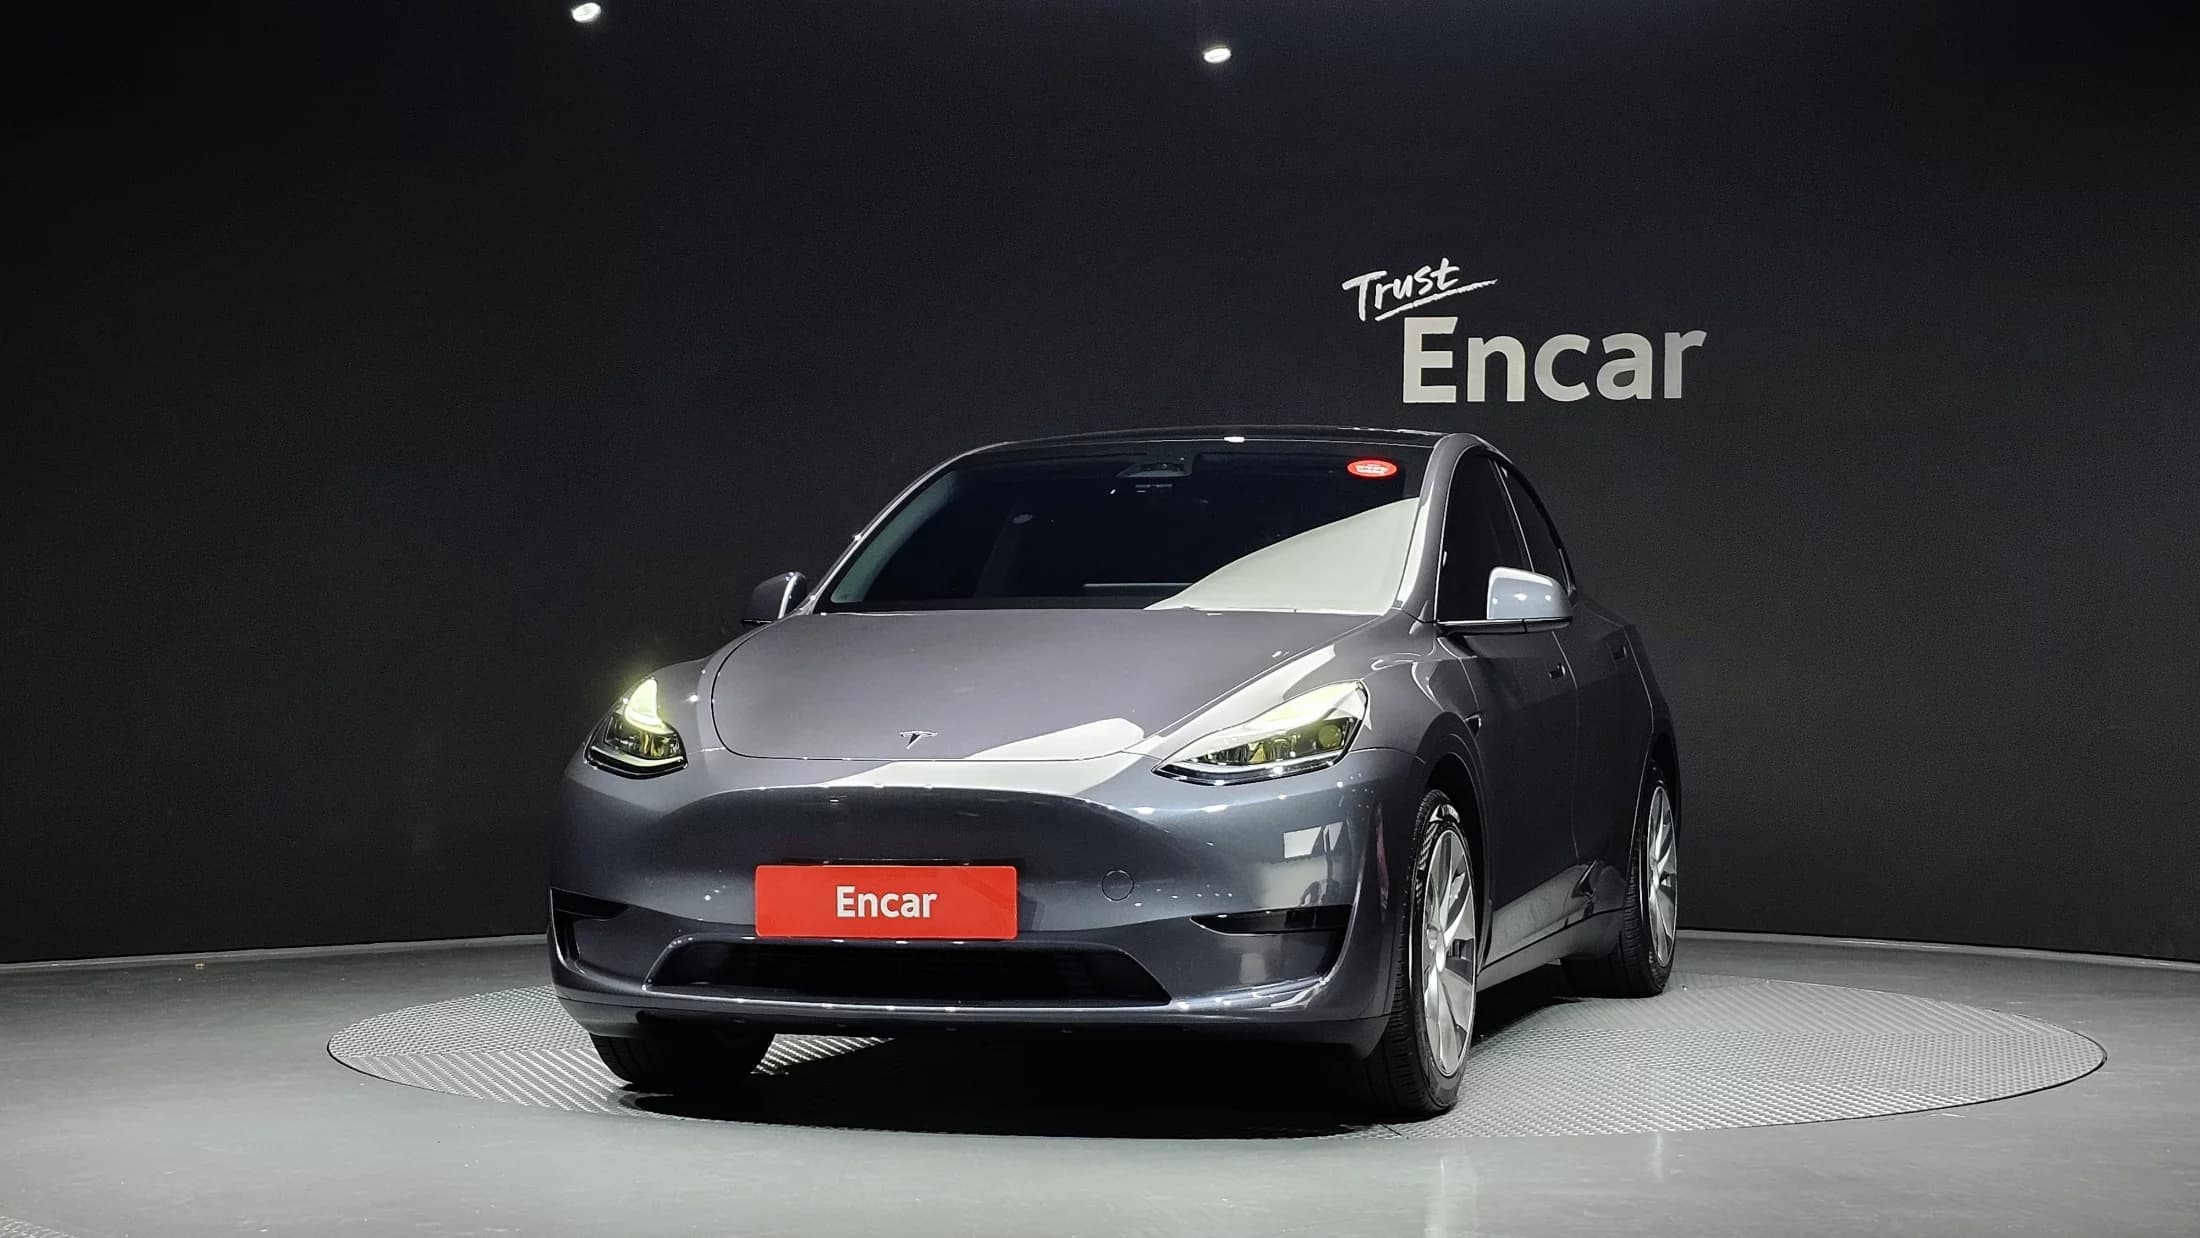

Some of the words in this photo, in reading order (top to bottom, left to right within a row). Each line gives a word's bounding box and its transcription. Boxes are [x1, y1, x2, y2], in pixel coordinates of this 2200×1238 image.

[1341, 257, 1462, 321] Trust
[1402, 316, 1708, 403] Encar
[836, 885, 938, 918] Encar
